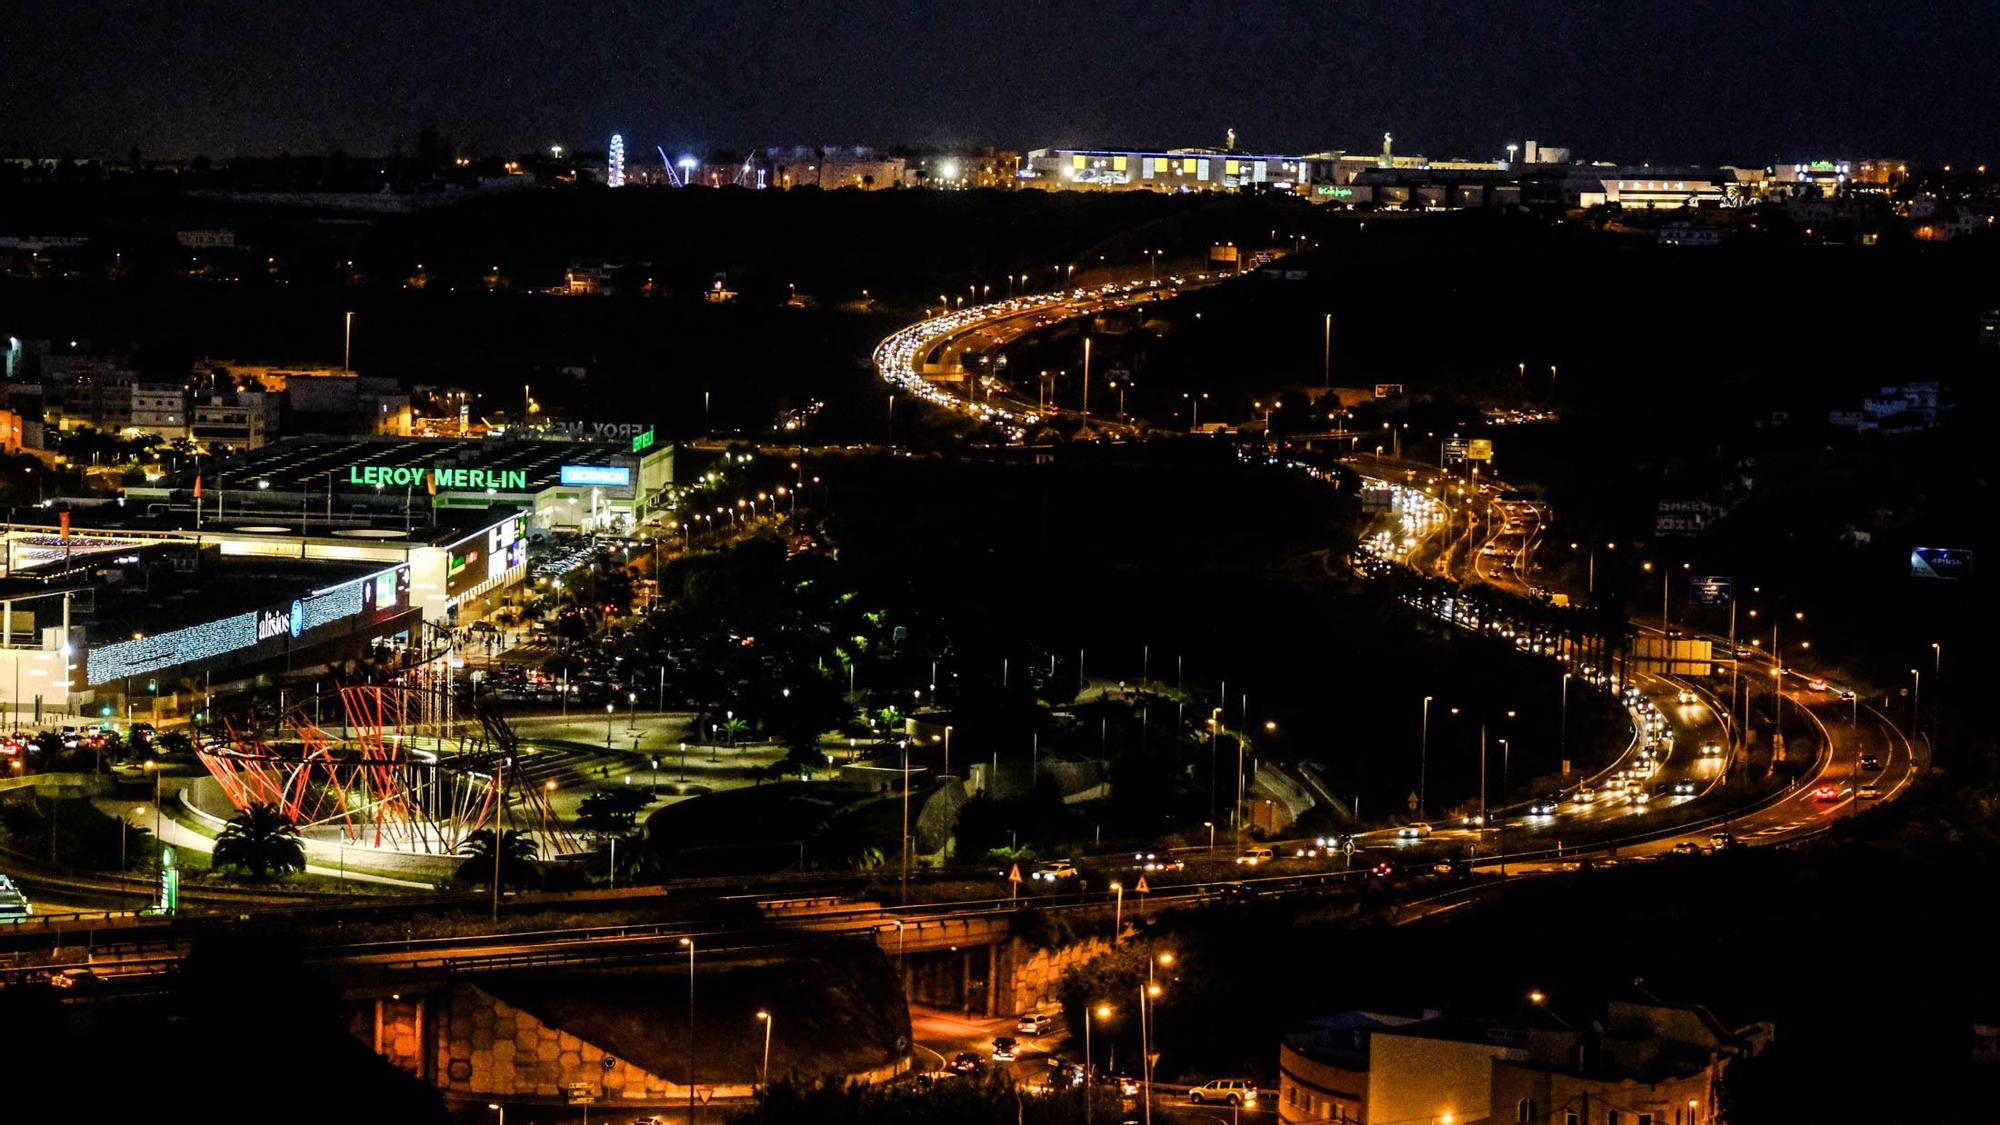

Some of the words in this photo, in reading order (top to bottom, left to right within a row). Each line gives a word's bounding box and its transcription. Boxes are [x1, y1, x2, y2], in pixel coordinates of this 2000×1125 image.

[350, 465, 425, 486] LEROY
[434, 468, 526, 489] MERLIN
[258, 610, 290, 640] alisios
